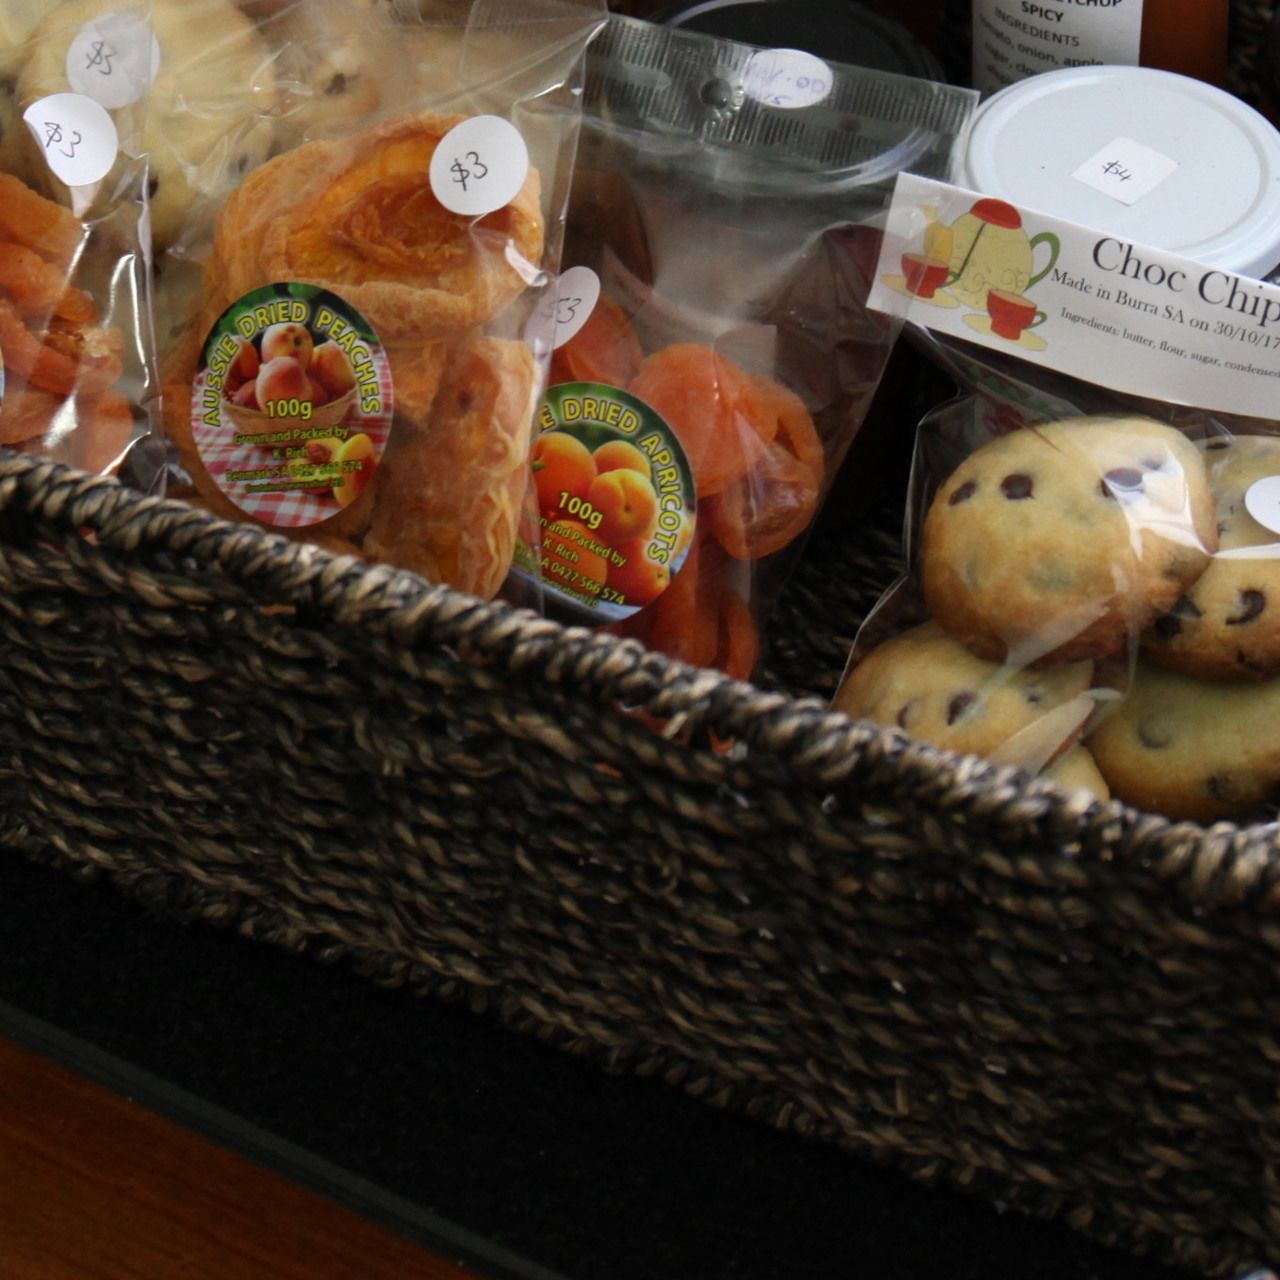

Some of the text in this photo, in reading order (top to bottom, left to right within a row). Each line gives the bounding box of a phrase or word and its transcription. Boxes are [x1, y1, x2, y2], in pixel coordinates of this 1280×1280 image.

[995, 7, 1080, 47] INGREDIENTS
[1021, 0, 1064, 22] SPICY
[450, 151, 488, 192] $3
[1092, 237, 1187, 293] Choc
[1050, 268, 1093, 294] Made
[1096, 283, 1111, 301] in
[1116, 289, 1159, 315] Burra
[1161, 304, 1185, 324] SA
[1189, 318, 1210, 332] on
[1060, 307, 1120, 336] Ingredients:
[1122, 327, 1157, 350] butter,
[1160, 340, 1188, 359] flour,
[1190, 352, 1222, 367] sugar,
[203, 300, 381, 427] AUSSIE DRIED PEACHES
[266, 398, 313, 420] 100g
[271, 430, 291, 442] and
[293, 427, 333, 440] Packed
[335, 425, 349, 439] by
[562, 397, 683, 565] DRIED APRICOTS
[559, 491, 604, 530] 100g
[549, 522, 627, 568] and Packed by
[555, 543, 581, 563] Rich
[551, 561, 579, 583] 0427
[581, 575, 601, 595] 566
[601, 586, 626, 606] 574
